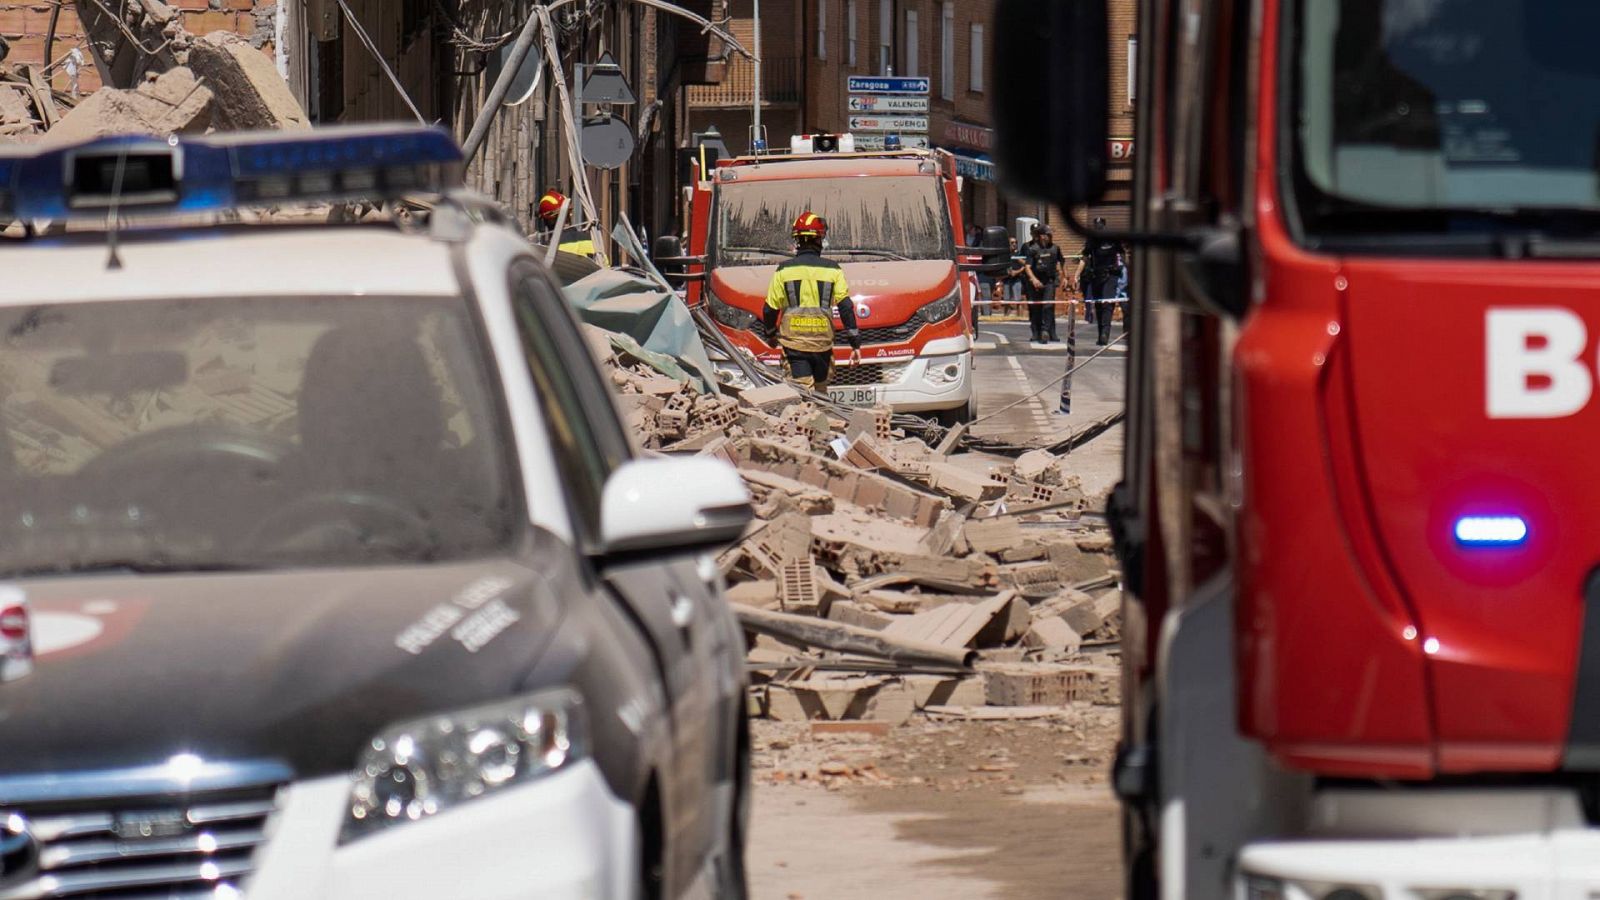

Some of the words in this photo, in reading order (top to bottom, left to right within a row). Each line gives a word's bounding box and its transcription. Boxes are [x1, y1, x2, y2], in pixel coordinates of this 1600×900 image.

[850, 80, 890, 90] Zaragoza
[888, 348, 915, 356] MAGIRUS
[1485, 306, 1600, 419] B
[849, 390, 873, 402] JBC
